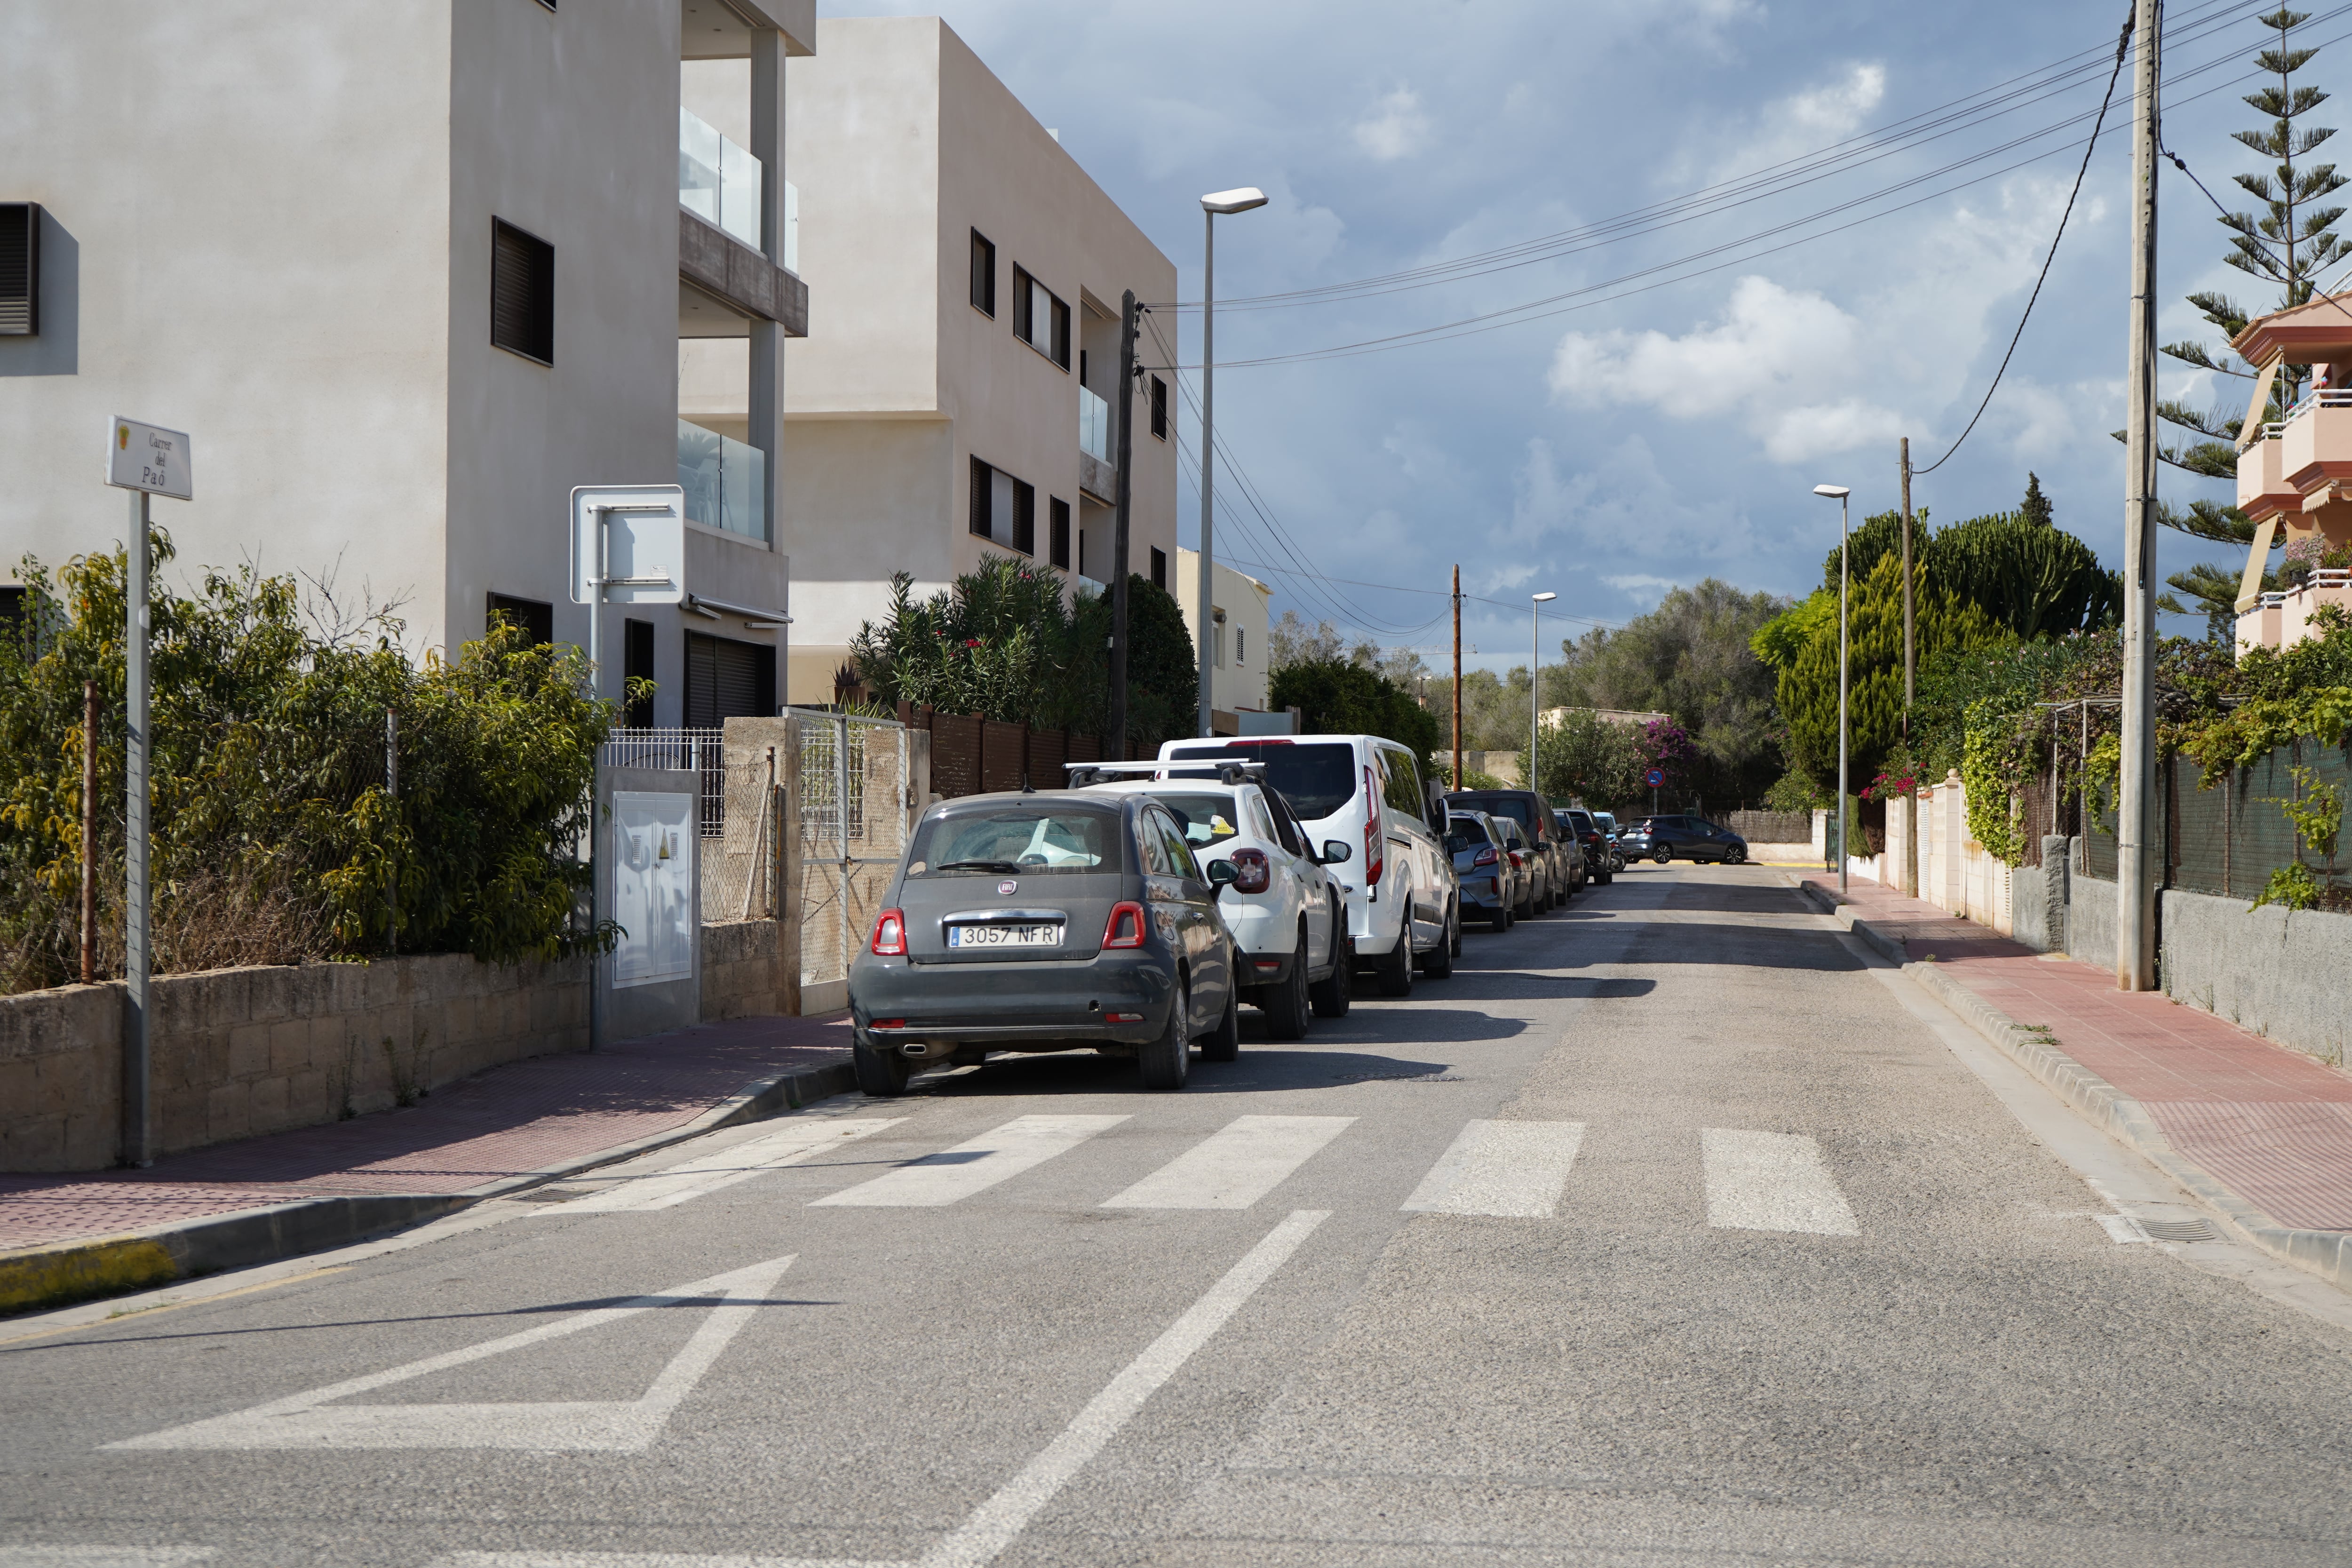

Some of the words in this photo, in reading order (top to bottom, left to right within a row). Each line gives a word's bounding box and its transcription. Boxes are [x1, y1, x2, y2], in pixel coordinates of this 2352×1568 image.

[149, 432, 172, 451] Carrer
[155, 451, 166, 467] del
[142, 466, 165, 486] Paó
[965, 927, 1011, 944] 3057
[1018, 926, 1053, 942] NFR
